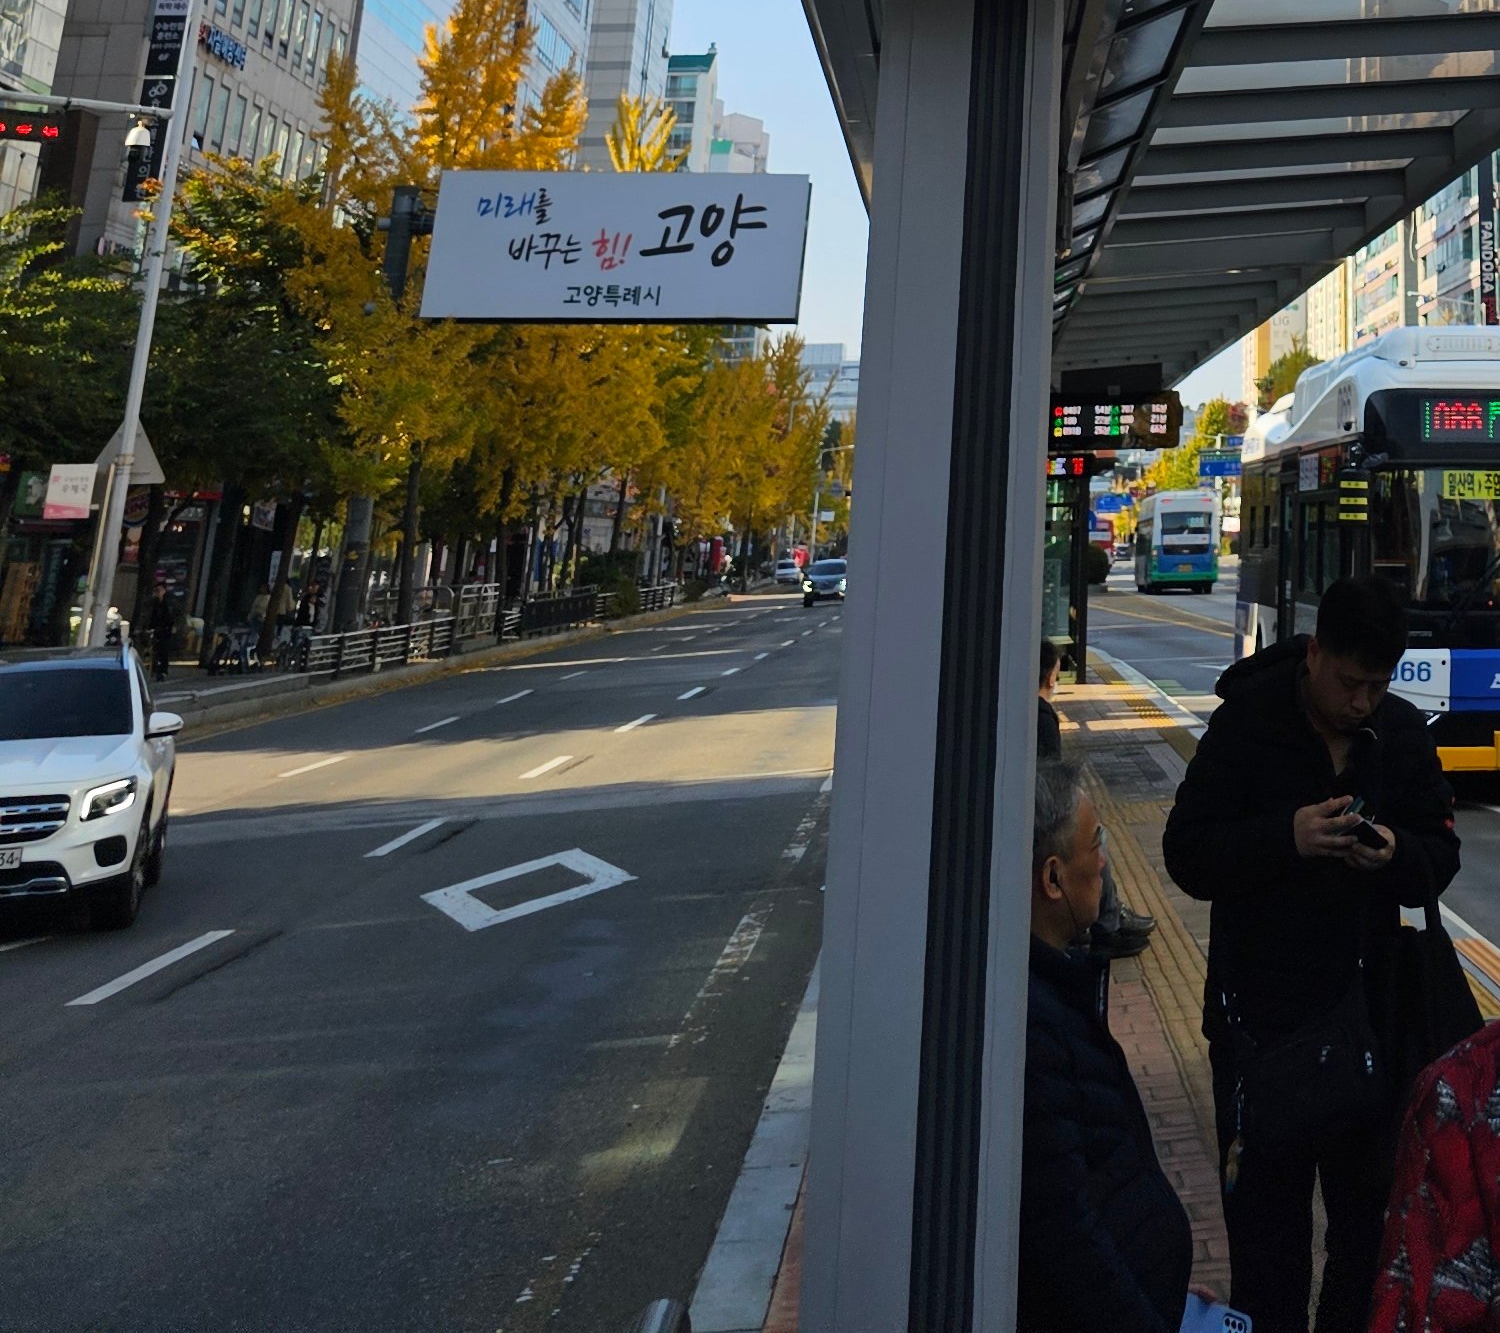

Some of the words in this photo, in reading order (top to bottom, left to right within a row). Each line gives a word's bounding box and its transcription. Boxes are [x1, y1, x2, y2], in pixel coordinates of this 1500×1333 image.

[477, 188, 554, 225] 미래를
[508, 233, 582, 270] 바꾸는
[591, 228, 633, 271] 힘!
[639, 193, 767, 267] 고양
[1480, 220, 1495, 293] PANDORA
[563, 284, 662, 307] 고양특례시
[1448, 472, 1475, 497] 일산역
